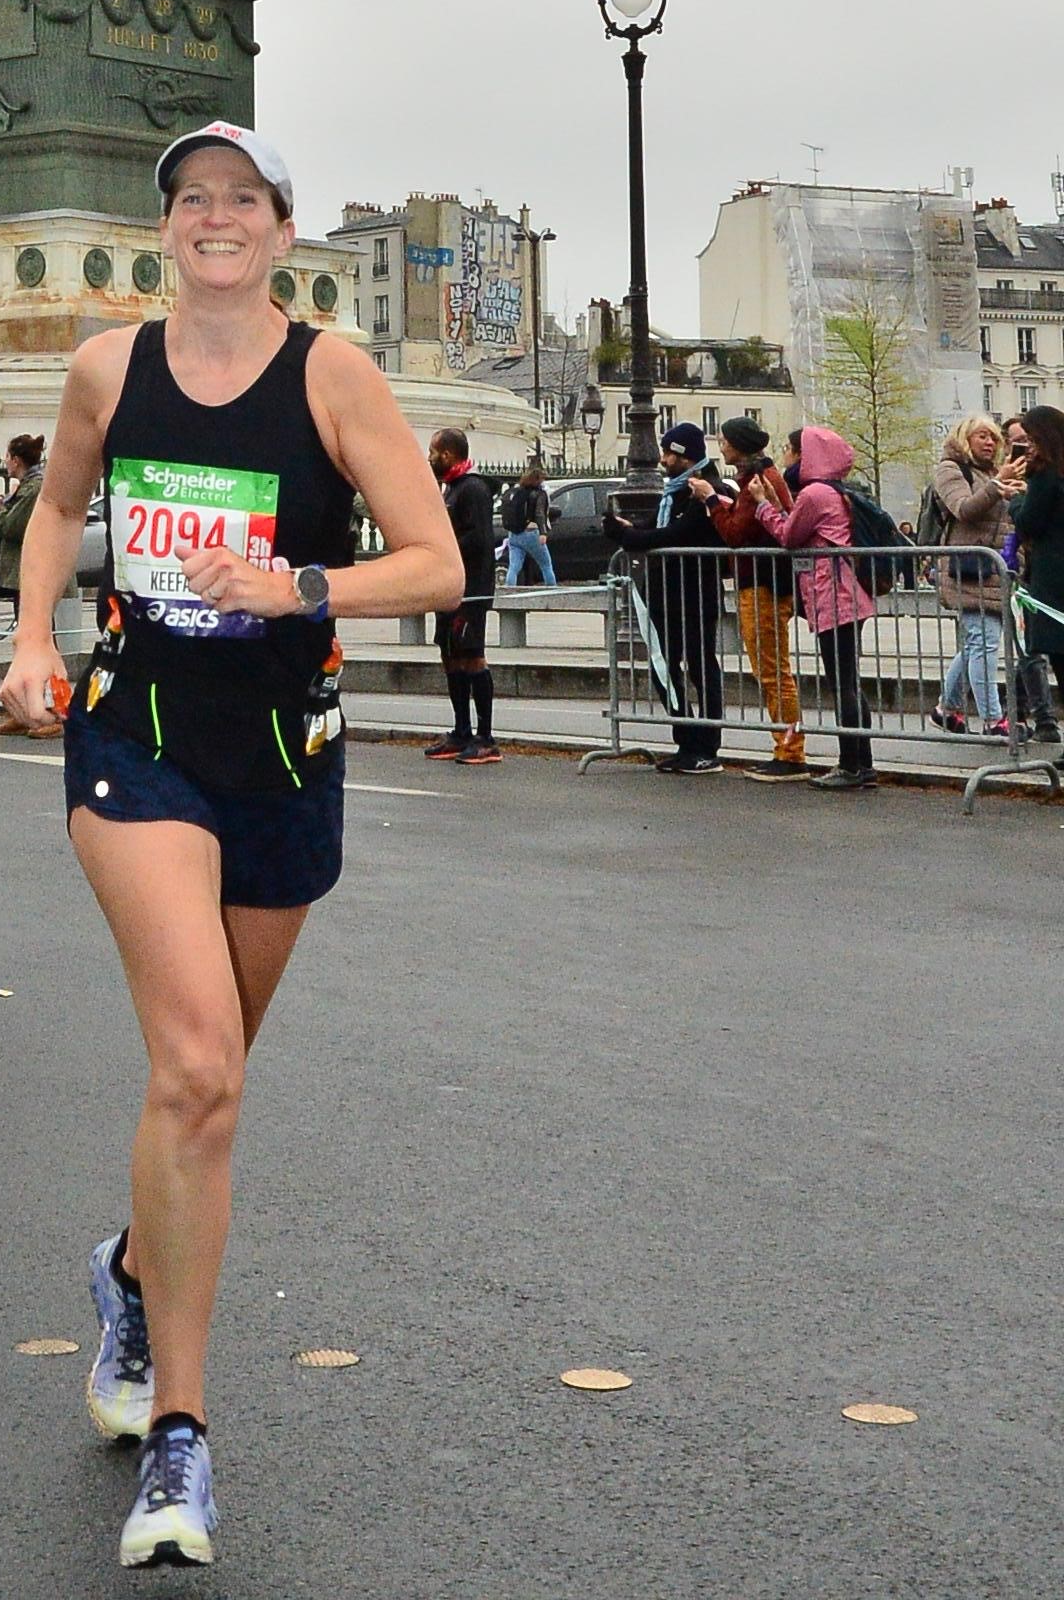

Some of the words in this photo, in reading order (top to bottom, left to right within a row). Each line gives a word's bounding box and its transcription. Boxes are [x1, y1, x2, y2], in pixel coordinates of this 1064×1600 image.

[155, 0, 172, 16] 28
[197, 8, 214, 24] 29
[184, 40, 219, 61] 1830
[143, 465, 237, 492] Schneider
[180, 487, 233, 503] Electric
[126, 504, 228, 558] 2094
[248, 536, 272, 558] 3h
[164, 608, 221, 629] asics
